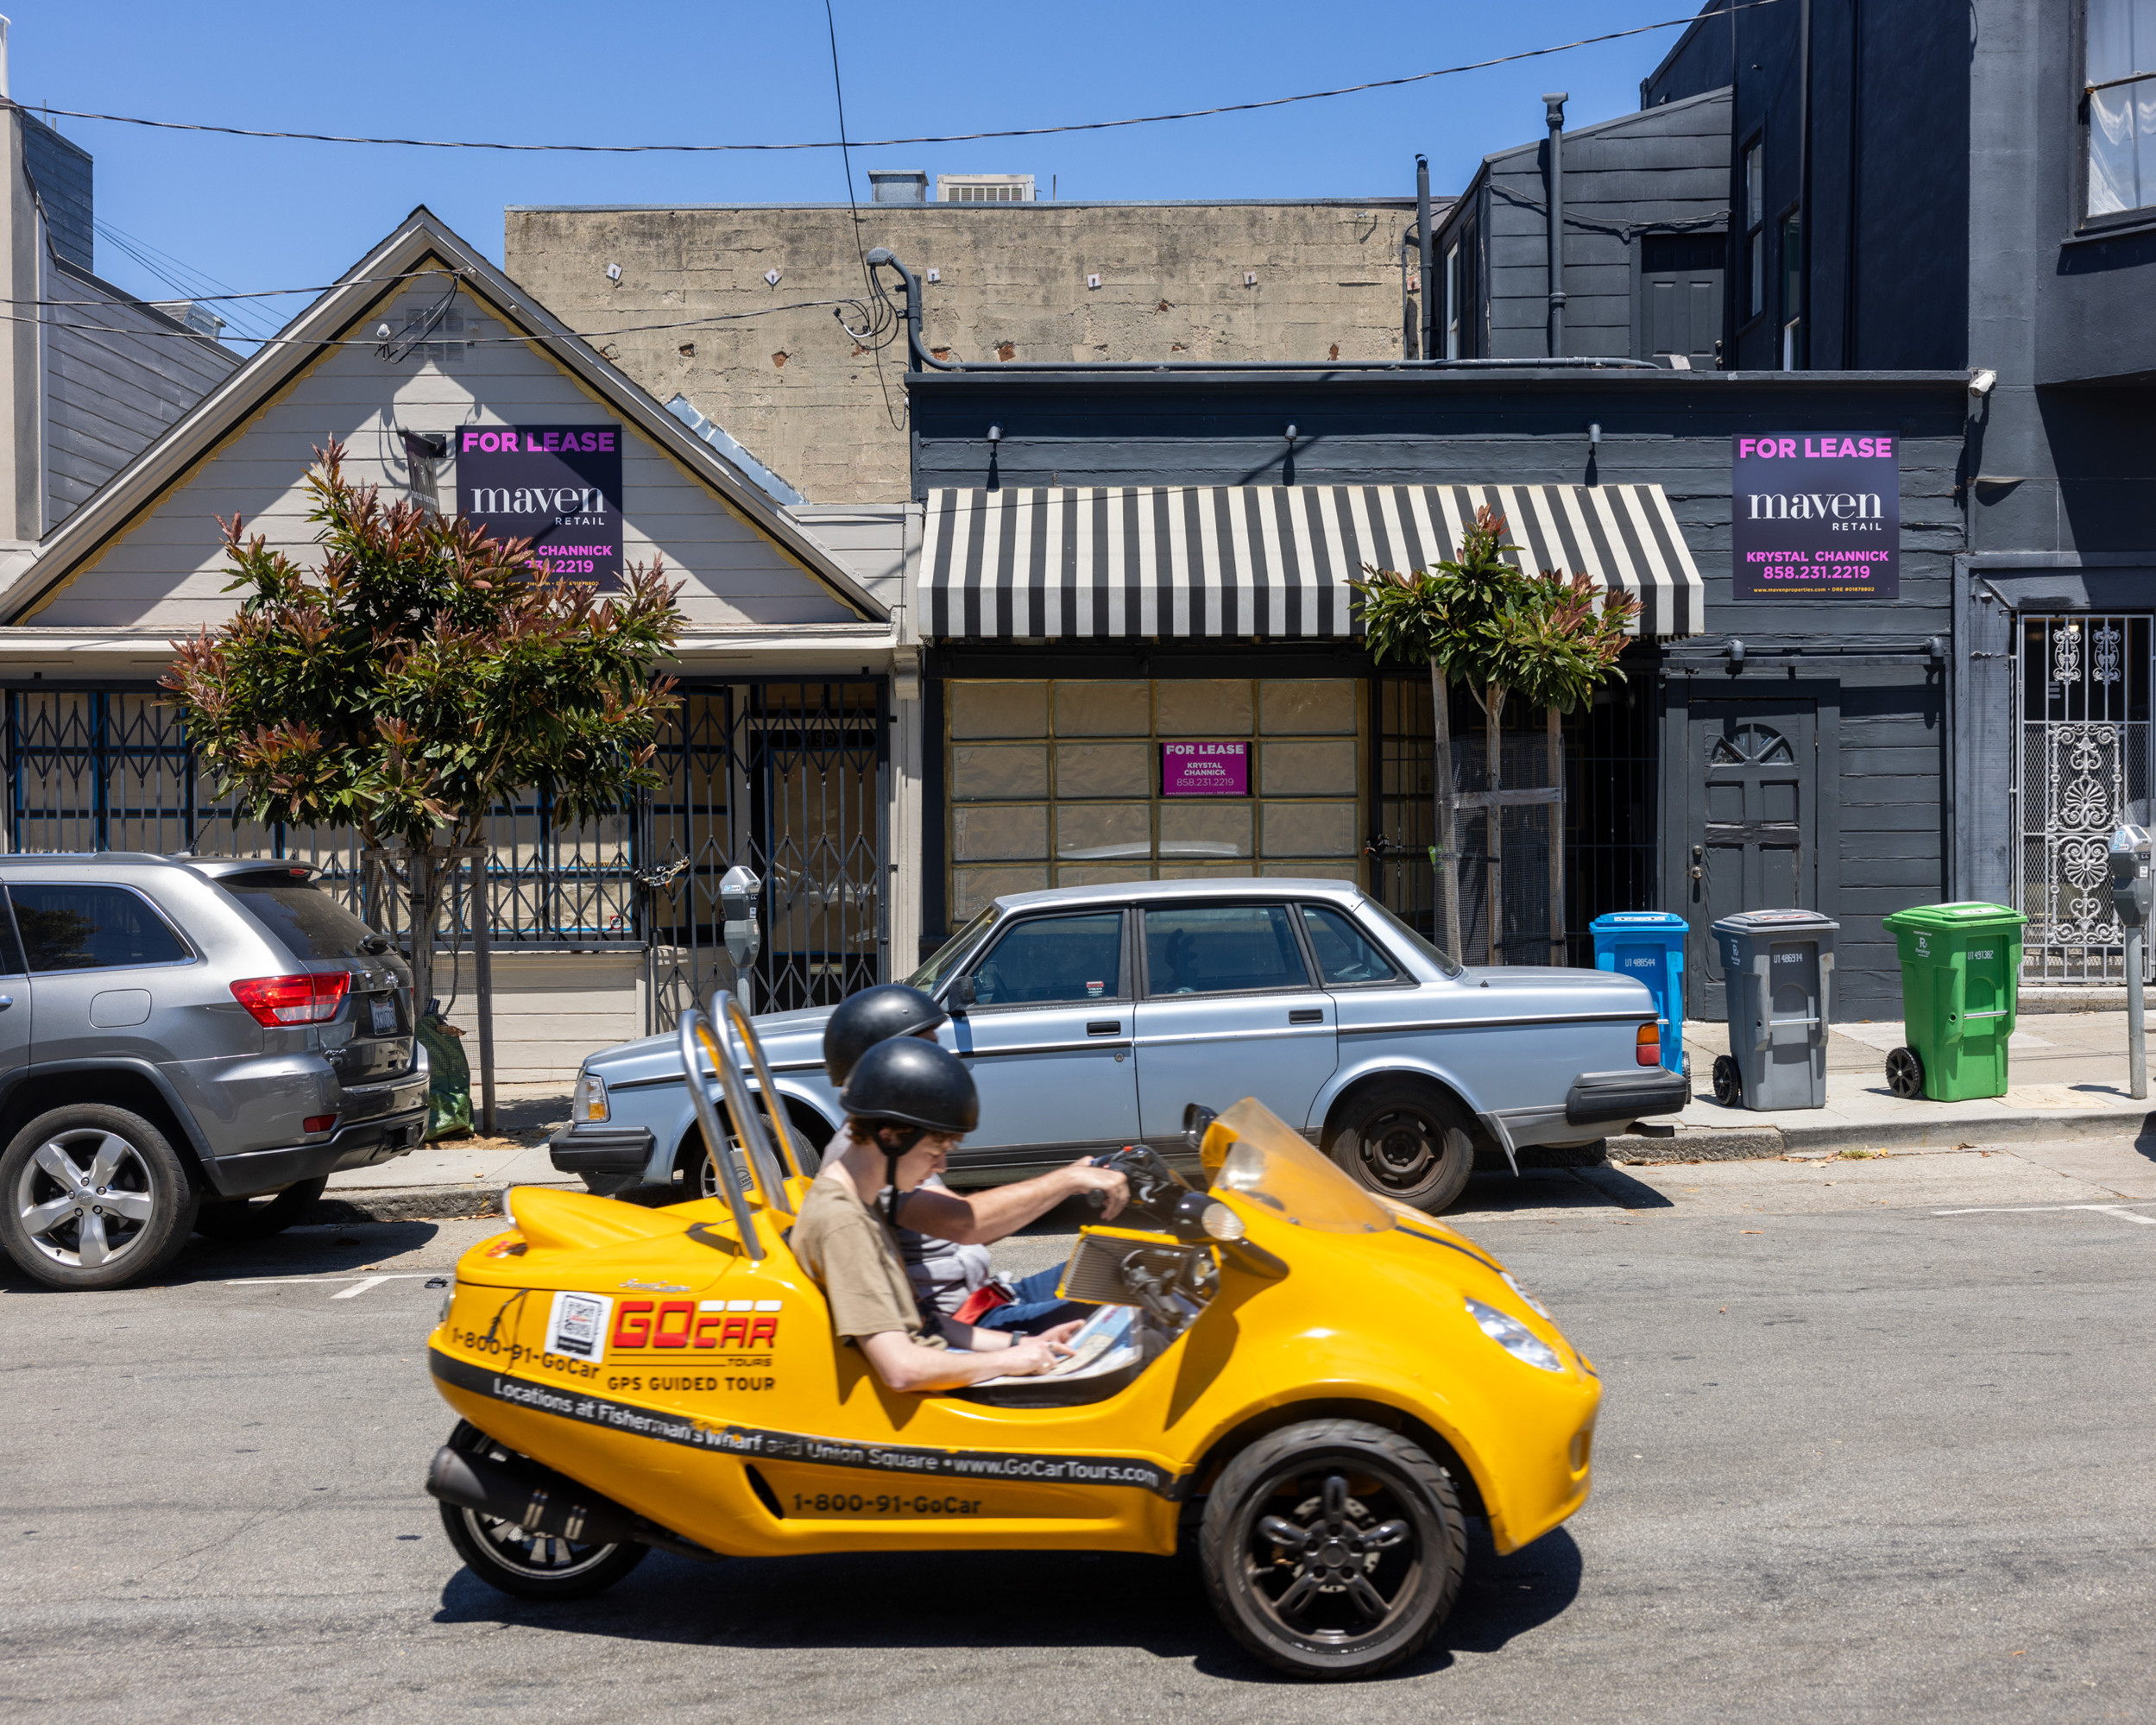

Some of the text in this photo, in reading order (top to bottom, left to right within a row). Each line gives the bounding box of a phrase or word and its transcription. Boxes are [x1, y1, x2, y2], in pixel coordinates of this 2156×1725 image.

[463, 432, 615, 452] FOR LEASE
[1740, 438, 1892, 458] FOR LEASE
[470, 488, 607, 513] maven
[1747, 493, 1884, 519] maven
[555, 517, 604, 526] RETAIL
[1832, 522, 1882, 531] RETAIL
[539, 545, 613, 557] CHANNICK
[1747, 551, 1889, 563] KRYSTAL CHANNICK
[1763, 565, 1870, 579] 858.231.2219
[1166, 745, 1244, 755] FOR LEASE
[1176, 778, 1234, 787] 858.231.2219
[728, 1358, 772, 1367] TOURS
[607, 1376, 776, 1391] GPS GUIDED TOUR
[493, 1377, 573, 1413] Locations
[575, 1401, 596, 1418] at
[806, 1442, 864, 1463] Union
[867, 1448, 939, 1470] Square
[953, 1458, 1159, 1487] www.GoCarTours.com
[794, 1493, 982, 1515] 1-800-91-GoCar
